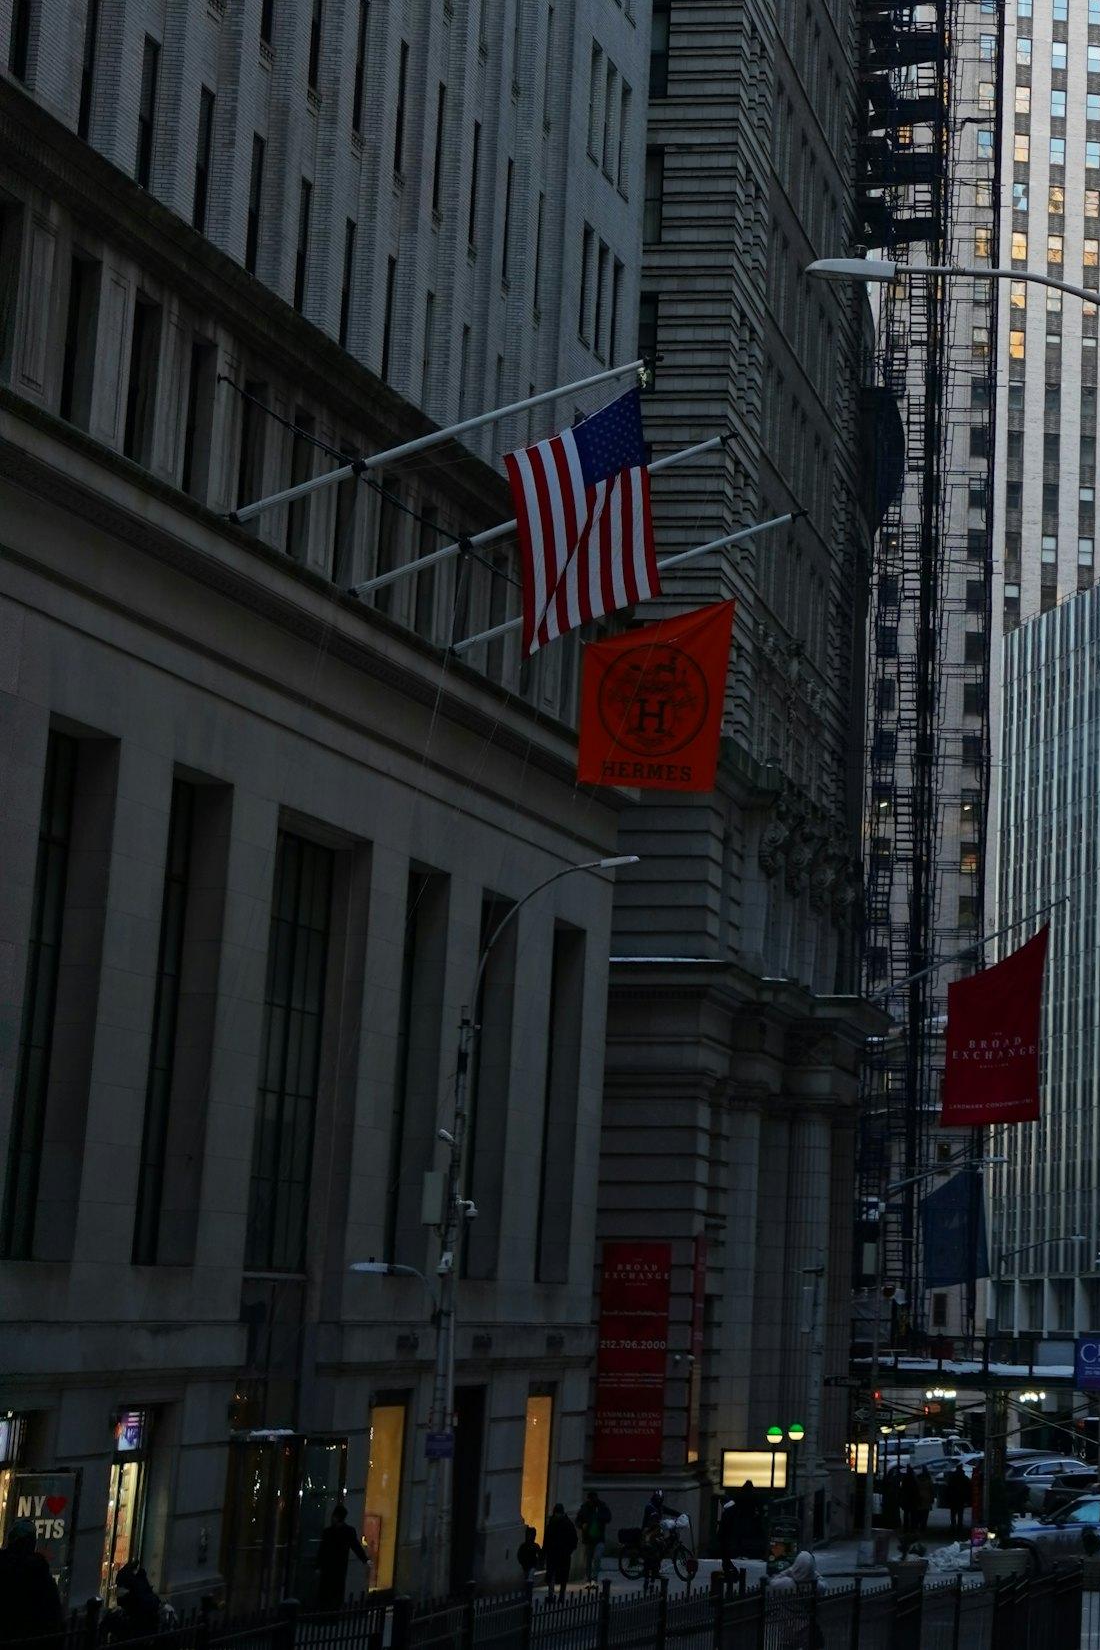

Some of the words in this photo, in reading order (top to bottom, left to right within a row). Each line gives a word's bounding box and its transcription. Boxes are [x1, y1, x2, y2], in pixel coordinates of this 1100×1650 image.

[968, 1036, 1022, 1050] BROAD
[952, 1044, 1036, 1061] EXCHANGE
[616, 1263, 659, 1271] BROAD
[604, 1271, 671, 1280] EXCHANGE
[17, 1495, 46, 1518] NY
[34, 1518, 65, 1540] FTS
